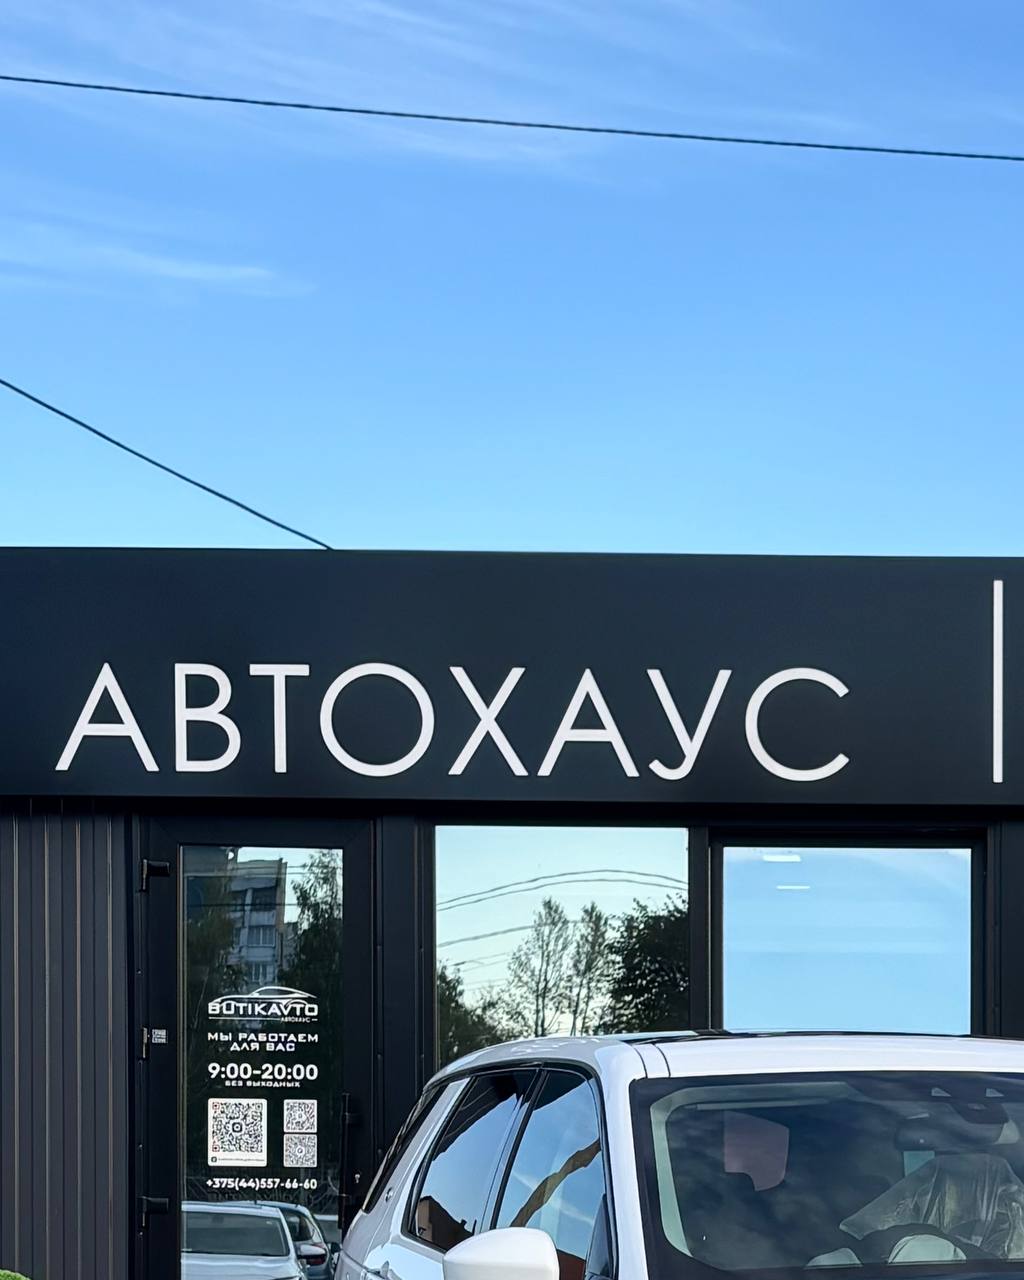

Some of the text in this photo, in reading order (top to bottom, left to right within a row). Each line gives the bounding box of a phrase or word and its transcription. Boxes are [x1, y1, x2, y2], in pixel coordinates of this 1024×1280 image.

[55, 662, 851, 782] АВТОХАУС
[208, 1002, 318, 1016] BUTIKAVTO
[208, 1032, 319, 1043] МЫ РАБОТАЕМ
[230, 1042, 296, 1052] ДЛЯ ВАС
[207, 1062, 319, 1081] 9:00-20:00
[246, 1080, 301, 1088] ВЫХОДНЫХ
[206, 1177, 318, 1191] +375(44)557-66-60
